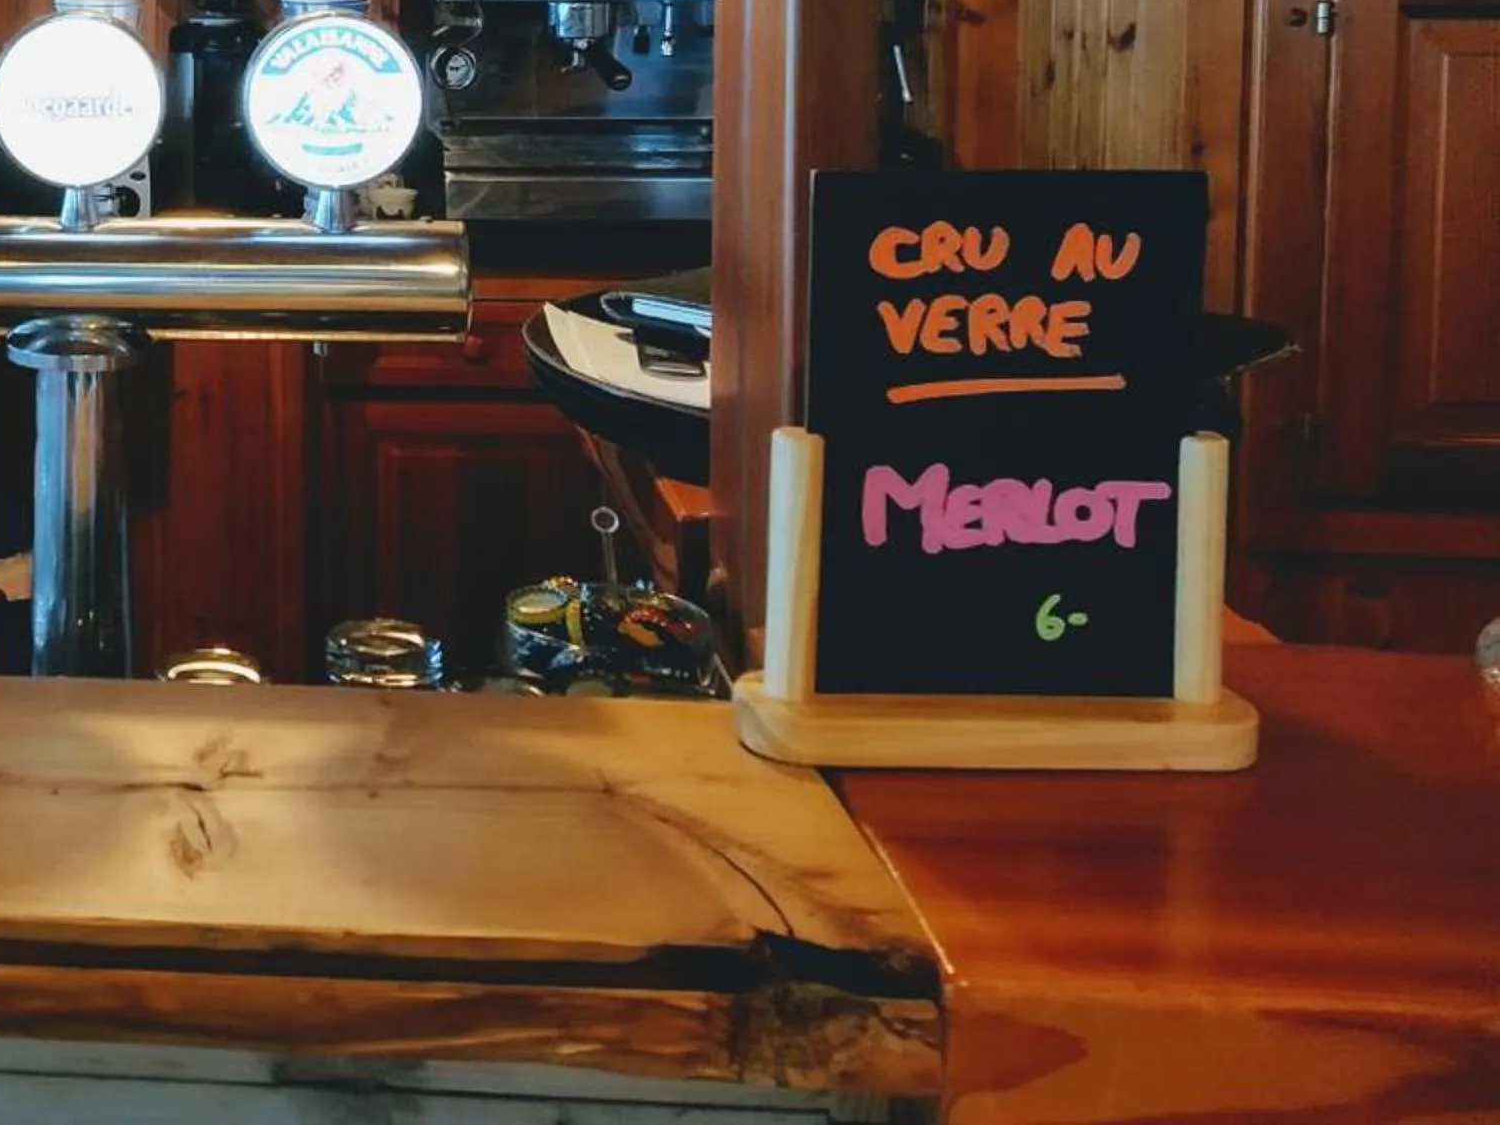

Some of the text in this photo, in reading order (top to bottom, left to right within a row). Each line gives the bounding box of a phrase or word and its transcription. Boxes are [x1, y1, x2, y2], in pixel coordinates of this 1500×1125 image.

[868, 220, 1143, 282] CRU AU
[876, 293, 1093, 358] VERRE
